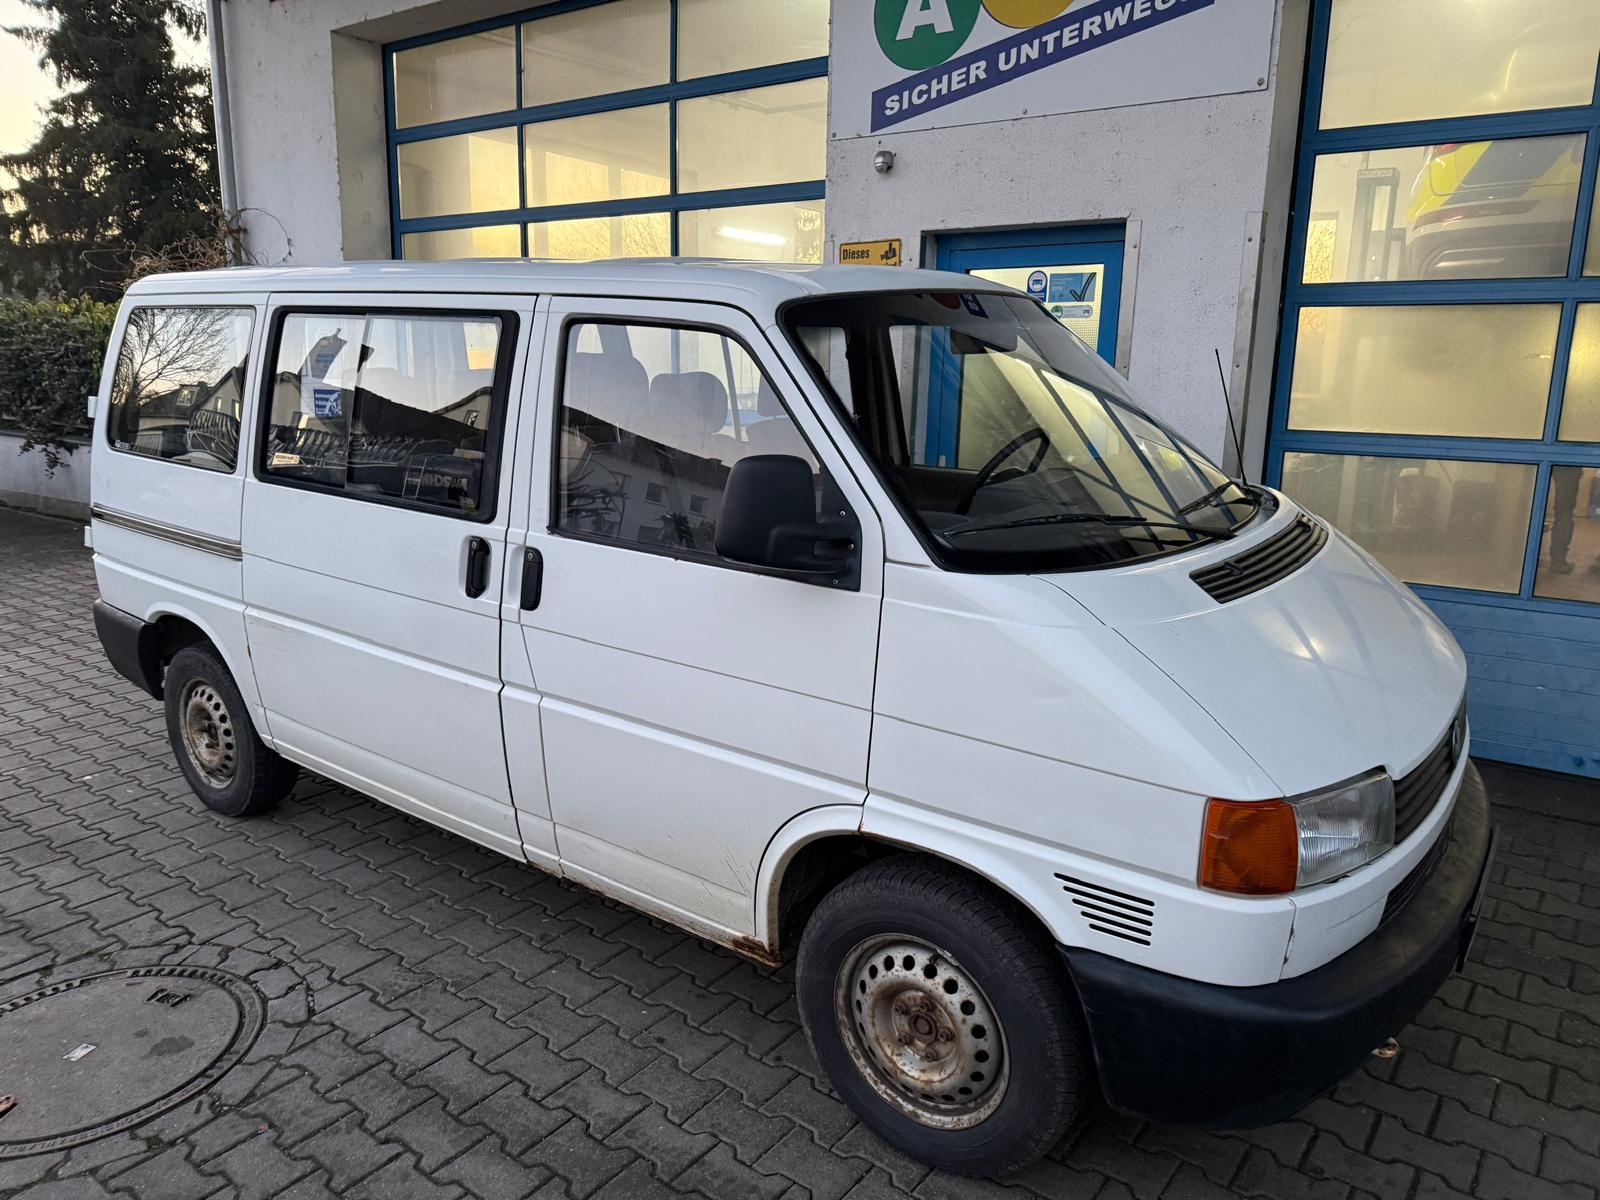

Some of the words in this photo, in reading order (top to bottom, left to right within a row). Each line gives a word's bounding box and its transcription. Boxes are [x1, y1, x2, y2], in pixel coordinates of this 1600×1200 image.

[896, 0, 954, 41] A
[884, 60, 987, 116] SICHER
[998, 0, 1187, 72] UNTERWEG
[843, 249, 870, 260] Dieses
